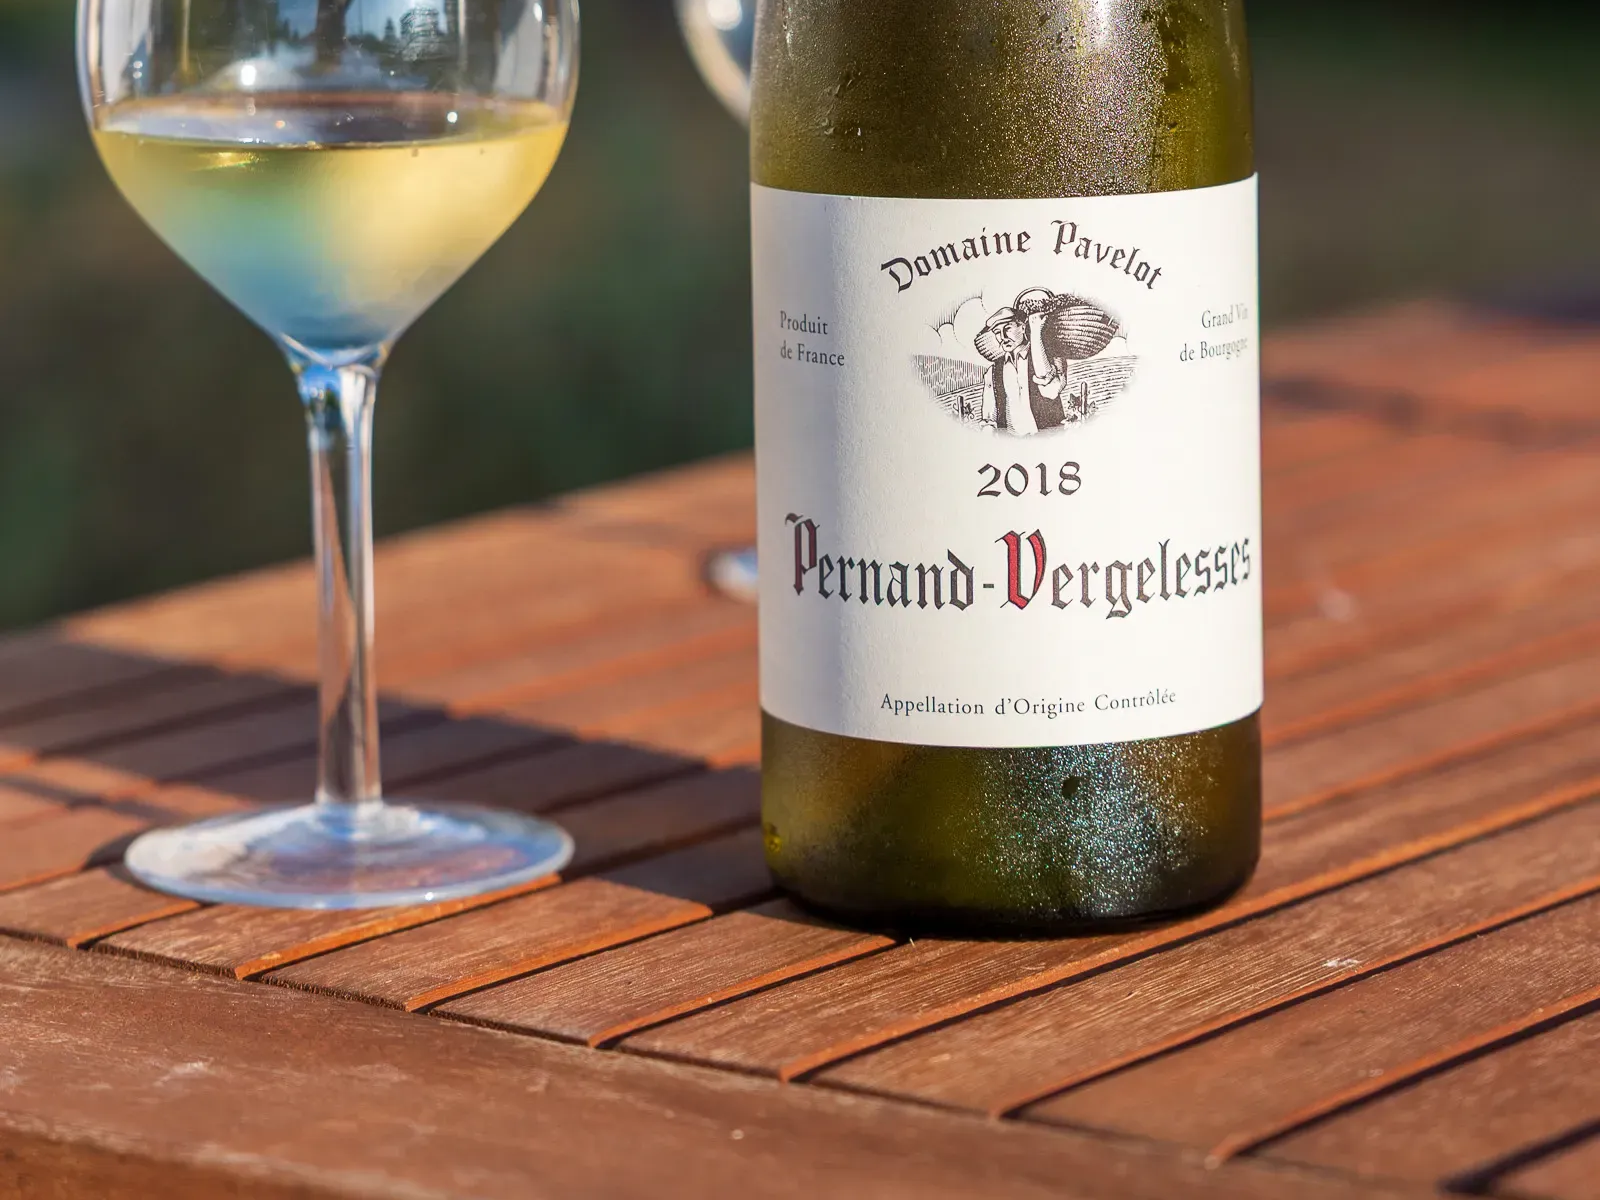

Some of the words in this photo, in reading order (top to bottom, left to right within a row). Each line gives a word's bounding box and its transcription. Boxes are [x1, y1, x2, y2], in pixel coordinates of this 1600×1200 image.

[881, 227, 1031, 293] Domaine
[1051, 219, 1163, 290] Pavelot
[780, 310, 828, 335] Produit
[1201, 304, 1234, 329] Grand
[780, 340, 793, 360] de
[797, 343, 845, 367] France
[1179, 343, 1195, 362] de
[976, 461, 1082, 497] 2018
[785, 513, 1252, 620] Pernand-Vergelesses
[880, 693, 985, 717] Appellation
[994, 697, 1086, 720] d'Origine
[1094, 688, 1177, 712] Contrôlée
